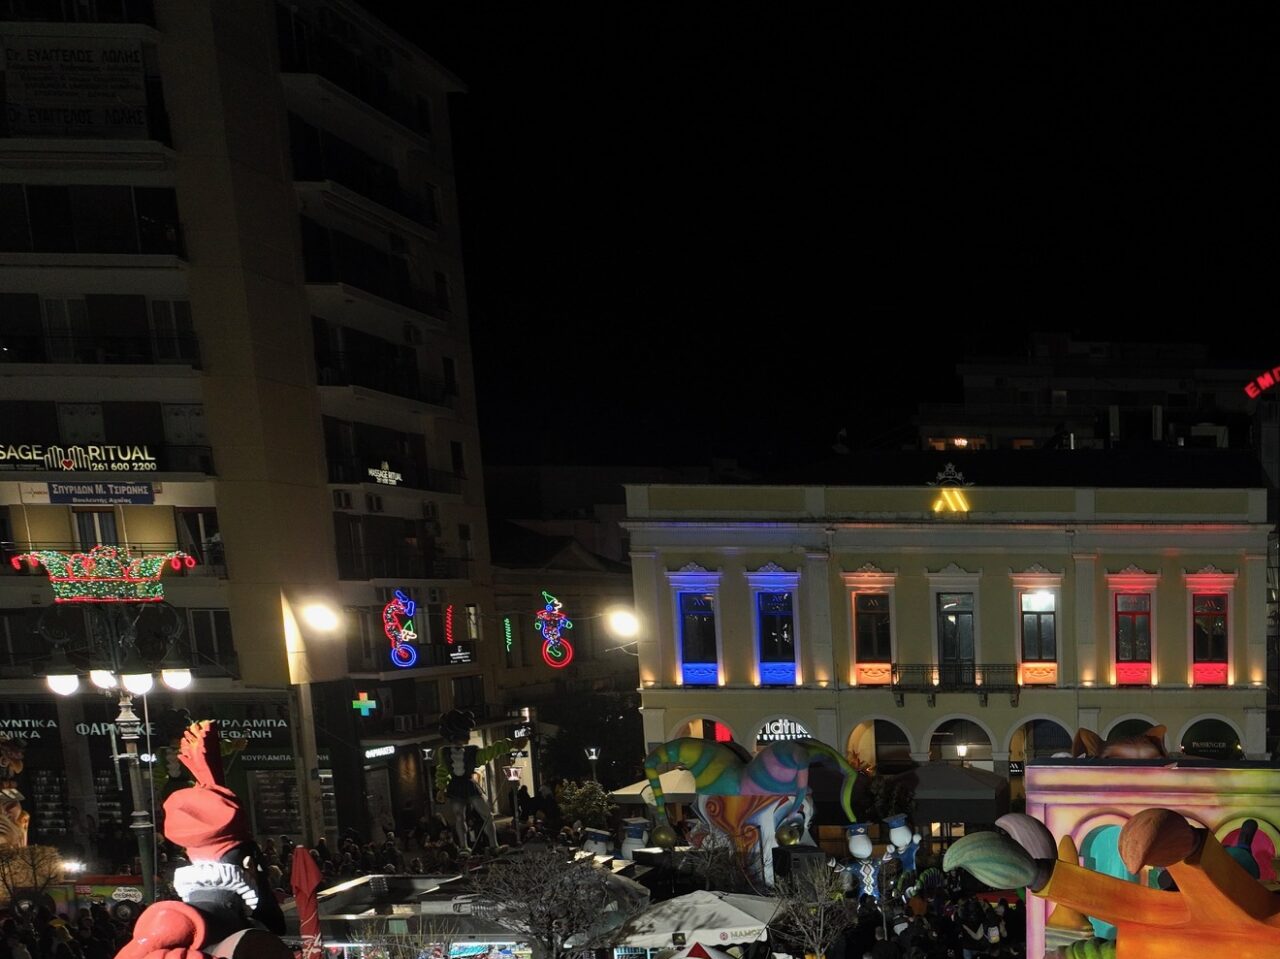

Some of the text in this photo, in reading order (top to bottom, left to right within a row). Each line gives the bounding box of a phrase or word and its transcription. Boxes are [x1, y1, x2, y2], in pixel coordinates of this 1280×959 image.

[89, 445, 156, 461] RITUAL
[92, 462, 156, 471] 261 600 2200
